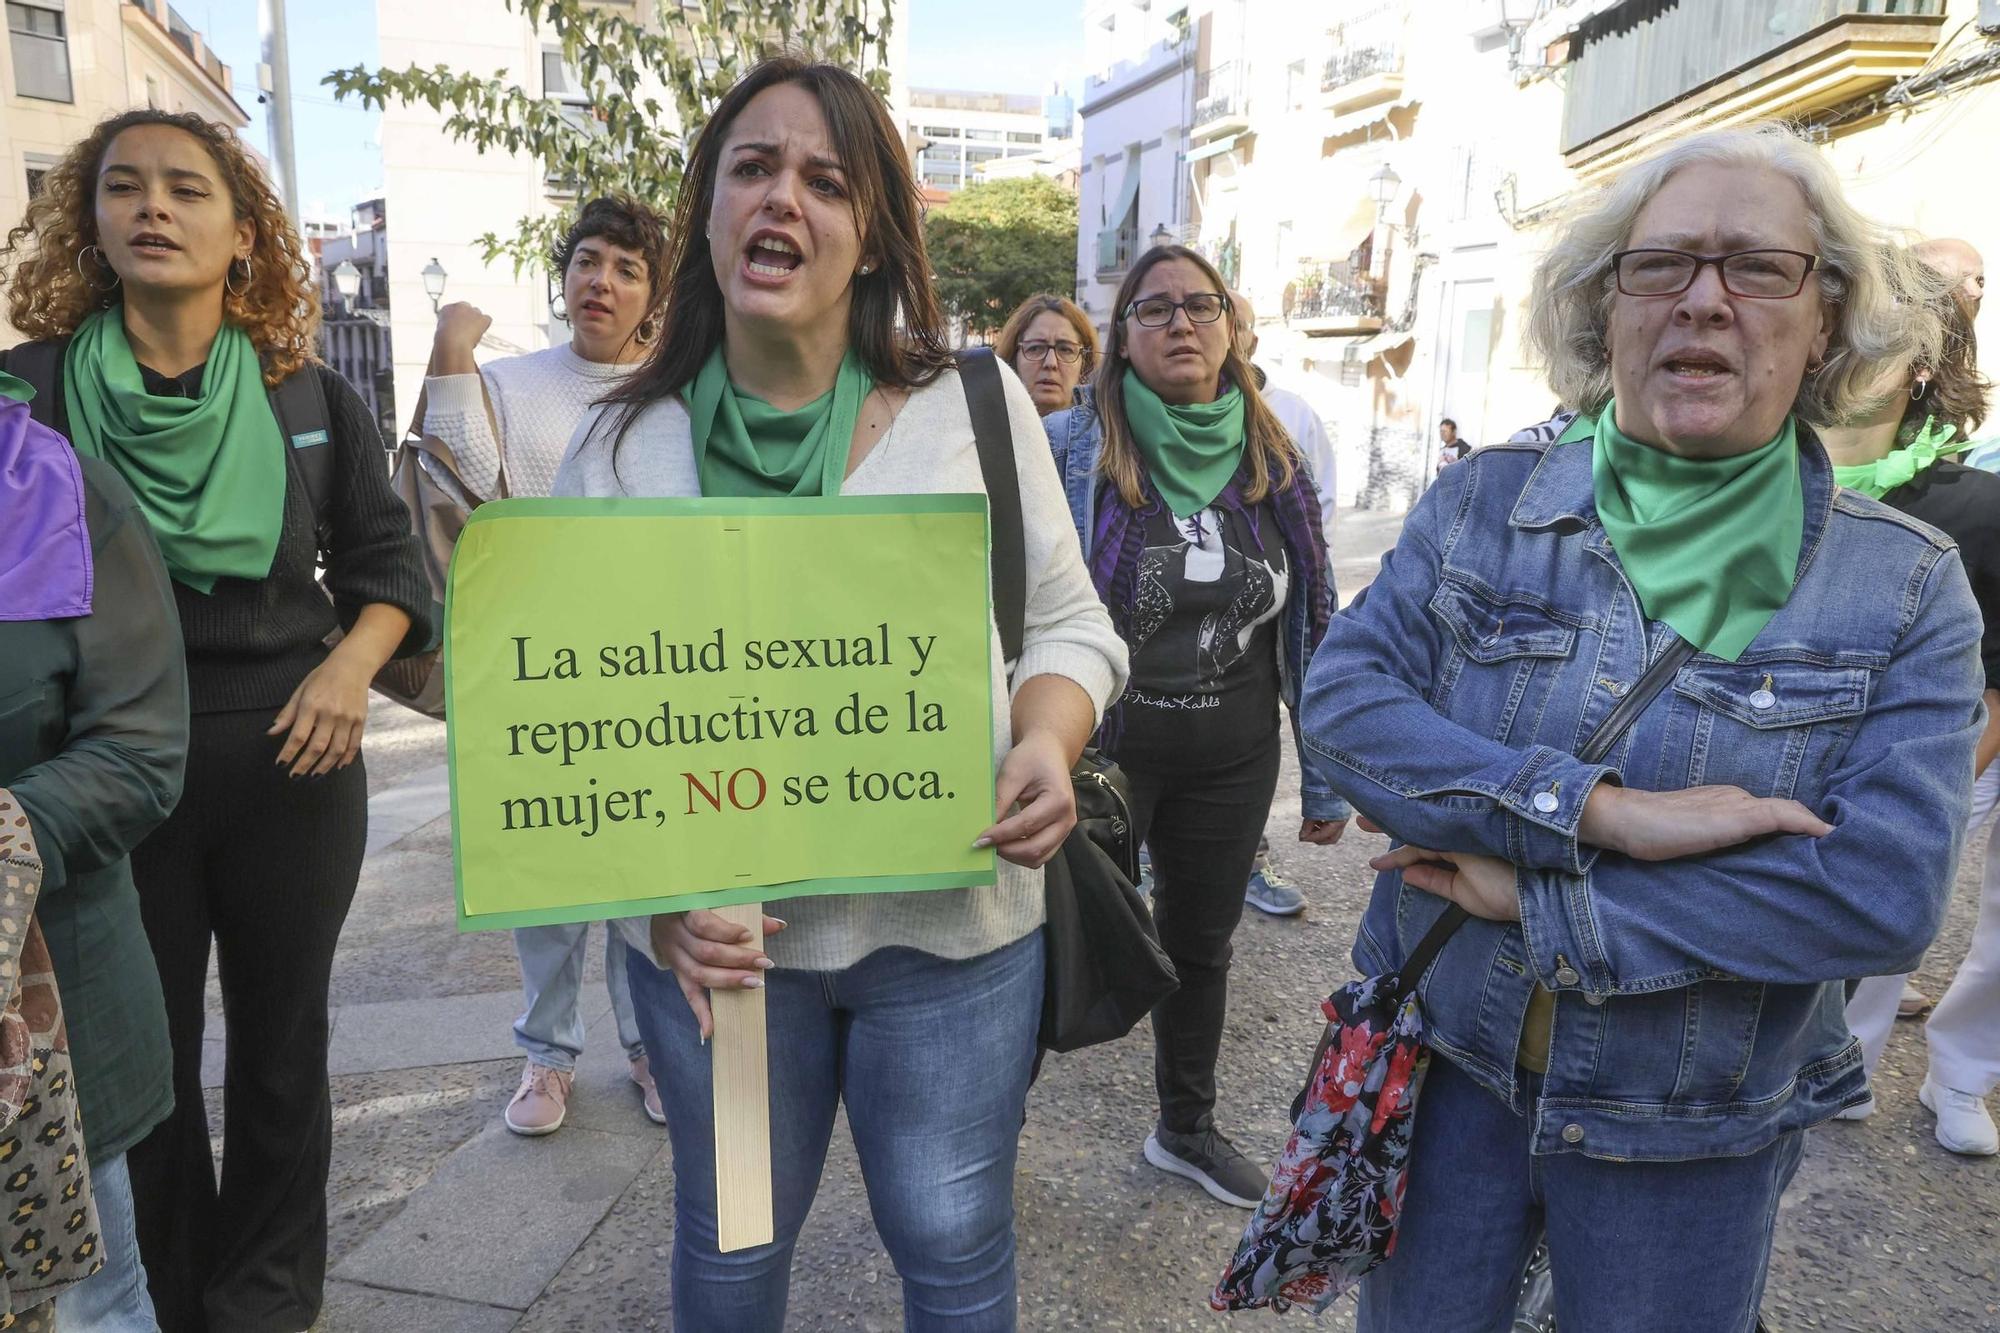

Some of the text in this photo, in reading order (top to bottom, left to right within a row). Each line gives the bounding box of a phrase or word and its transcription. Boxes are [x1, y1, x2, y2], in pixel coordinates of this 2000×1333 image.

[510, 622, 938, 682] La salud sexual y
[506, 689, 948, 767] reproductiva de la
[1123, 689, 1221, 709] Frida Kahlo
[500, 766, 955, 838] mujer, NO se toca.
